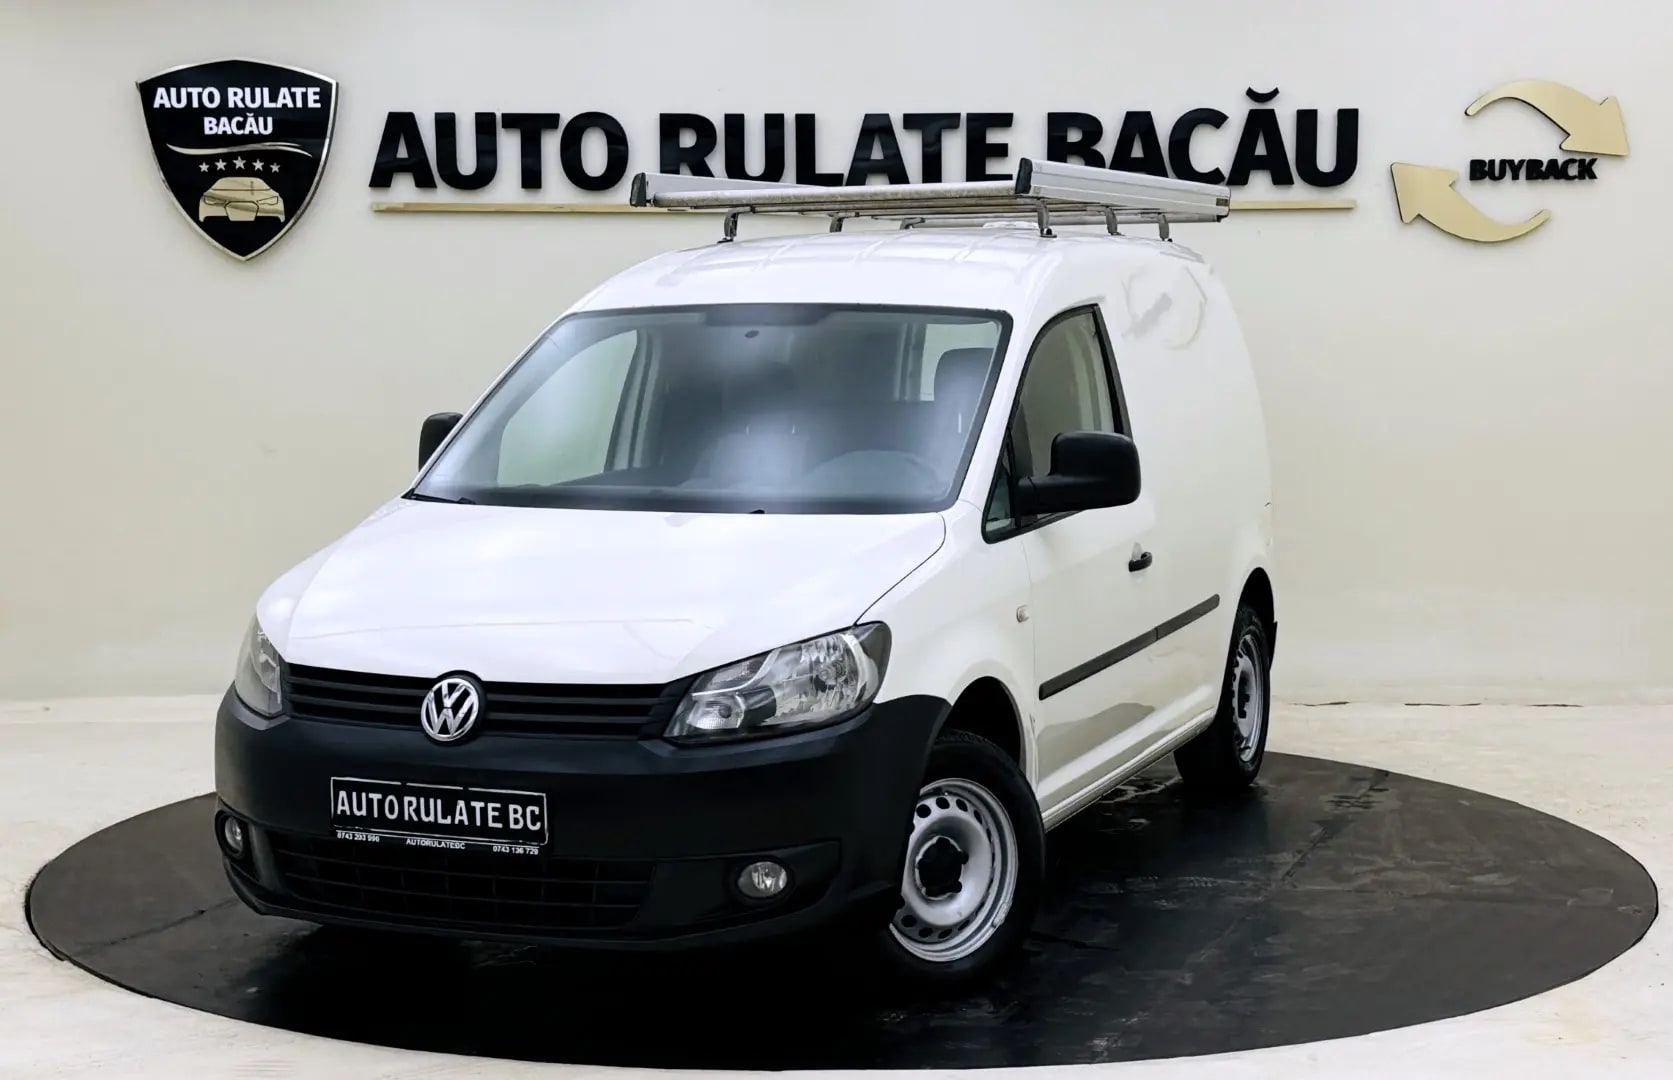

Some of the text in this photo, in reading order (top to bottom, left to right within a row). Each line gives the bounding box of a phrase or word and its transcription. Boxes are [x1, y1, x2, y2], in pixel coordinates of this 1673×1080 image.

[153, 86, 321, 109] AUTO RULATE
[203, 112, 274, 136] BACĂU
[368, 87, 1359, 191] AUTO RULATE BACĂU
[1469, 158, 1598, 182] BUYBACK
[336, 790, 542, 831] AUTO RULATE BC
[405, 838, 466, 849] AUTORULATEBC
